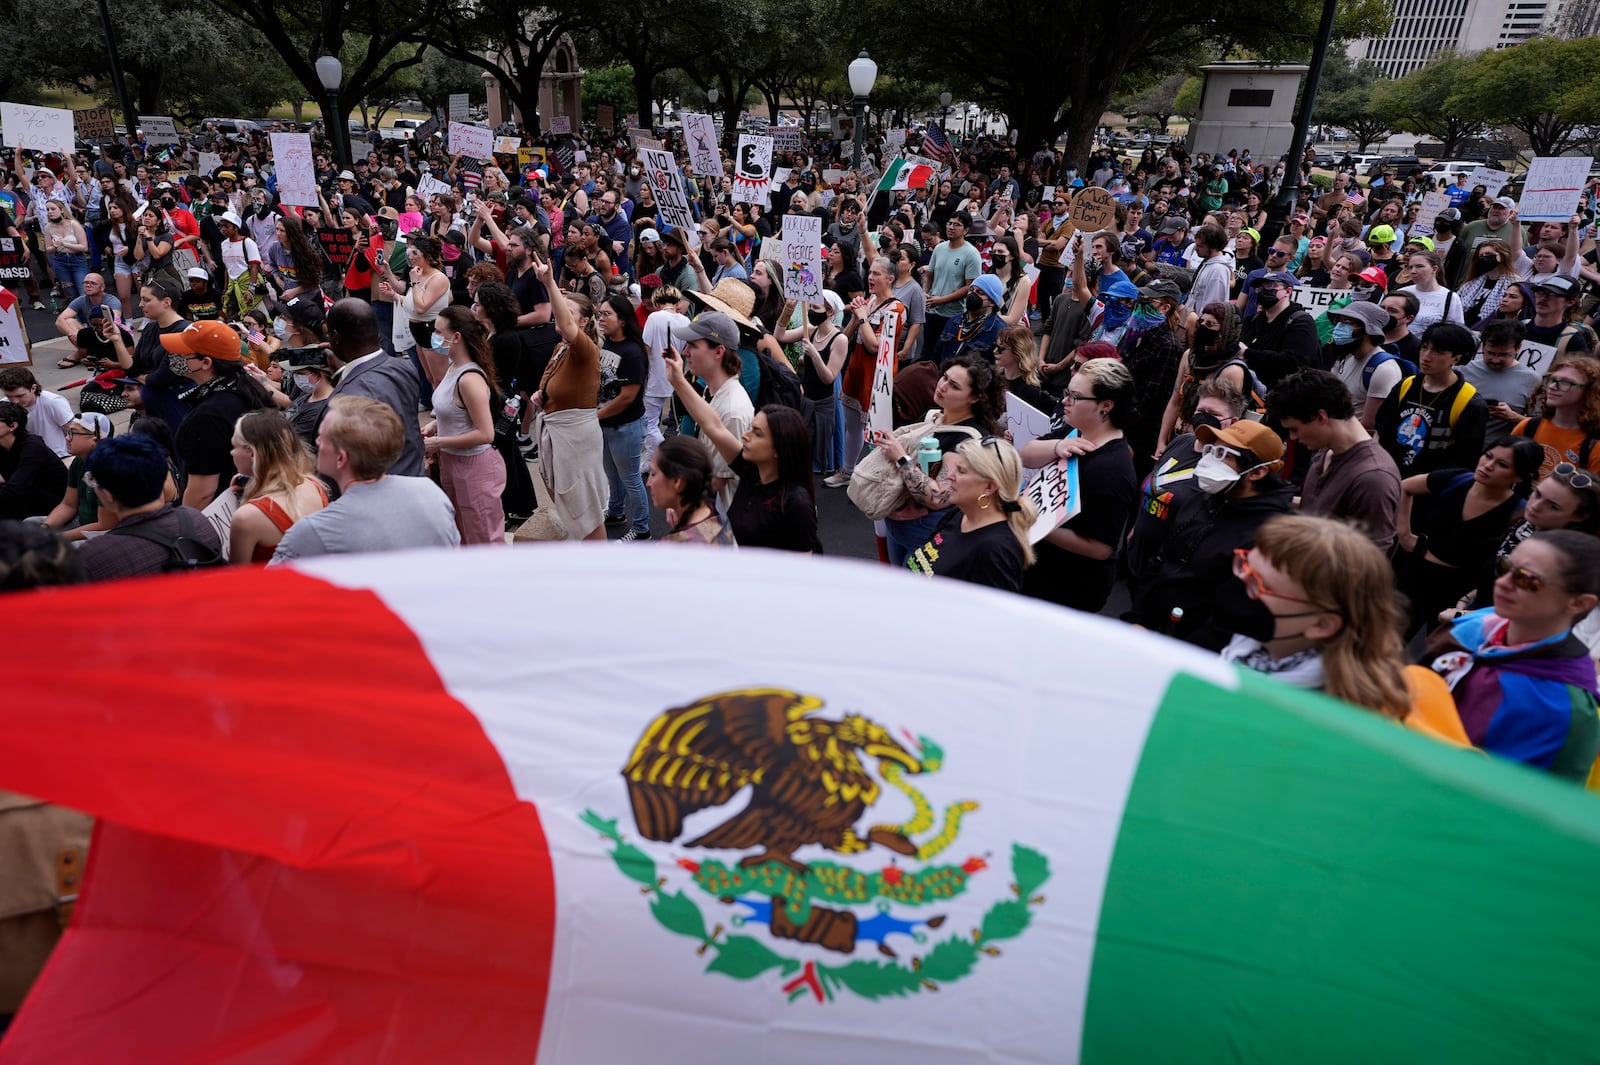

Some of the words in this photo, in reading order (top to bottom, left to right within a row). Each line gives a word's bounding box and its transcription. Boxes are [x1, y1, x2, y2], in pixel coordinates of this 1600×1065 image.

[14, 107, 39, 122] SAY
[45, 112, 60, 120] NO
[75, 110, 106, 122] STOP
[687, 114, 706, 130] EAT
[80, 121, 109, 129] PROJECT
[17, 132, 58, 148] 2025
[82, 128, 111, 138] 2025
[743, 136, 771, 146] SMASH
[647, 151, 669, 170] NO
[695, 152, 713, 164] THE
[695, 160, 719, 174] RICH
[1535, 159, 1560, 174] THE
[1563, 159, 1588, 174] REAL
[1528, 174, 1580, 190] CRIMINAL
[655, 189, 687, 211] BULL
[1525, 193, 1535, 201] IS
[1540, 192, 1550, 202] IN
[1553, 192, 1571, 202] THE
[1520, 203, 1545, 214] WHITE
[1546, 202, 1576, 213] HOUSE
[661, 207, 690, 228] SHIT
[784, 217, 798, 231] OUR
[800, 217, 818, 233] LOVE
[335, 233, 348, 242] OUT
[1046, 461, 1071, 513] rotect
